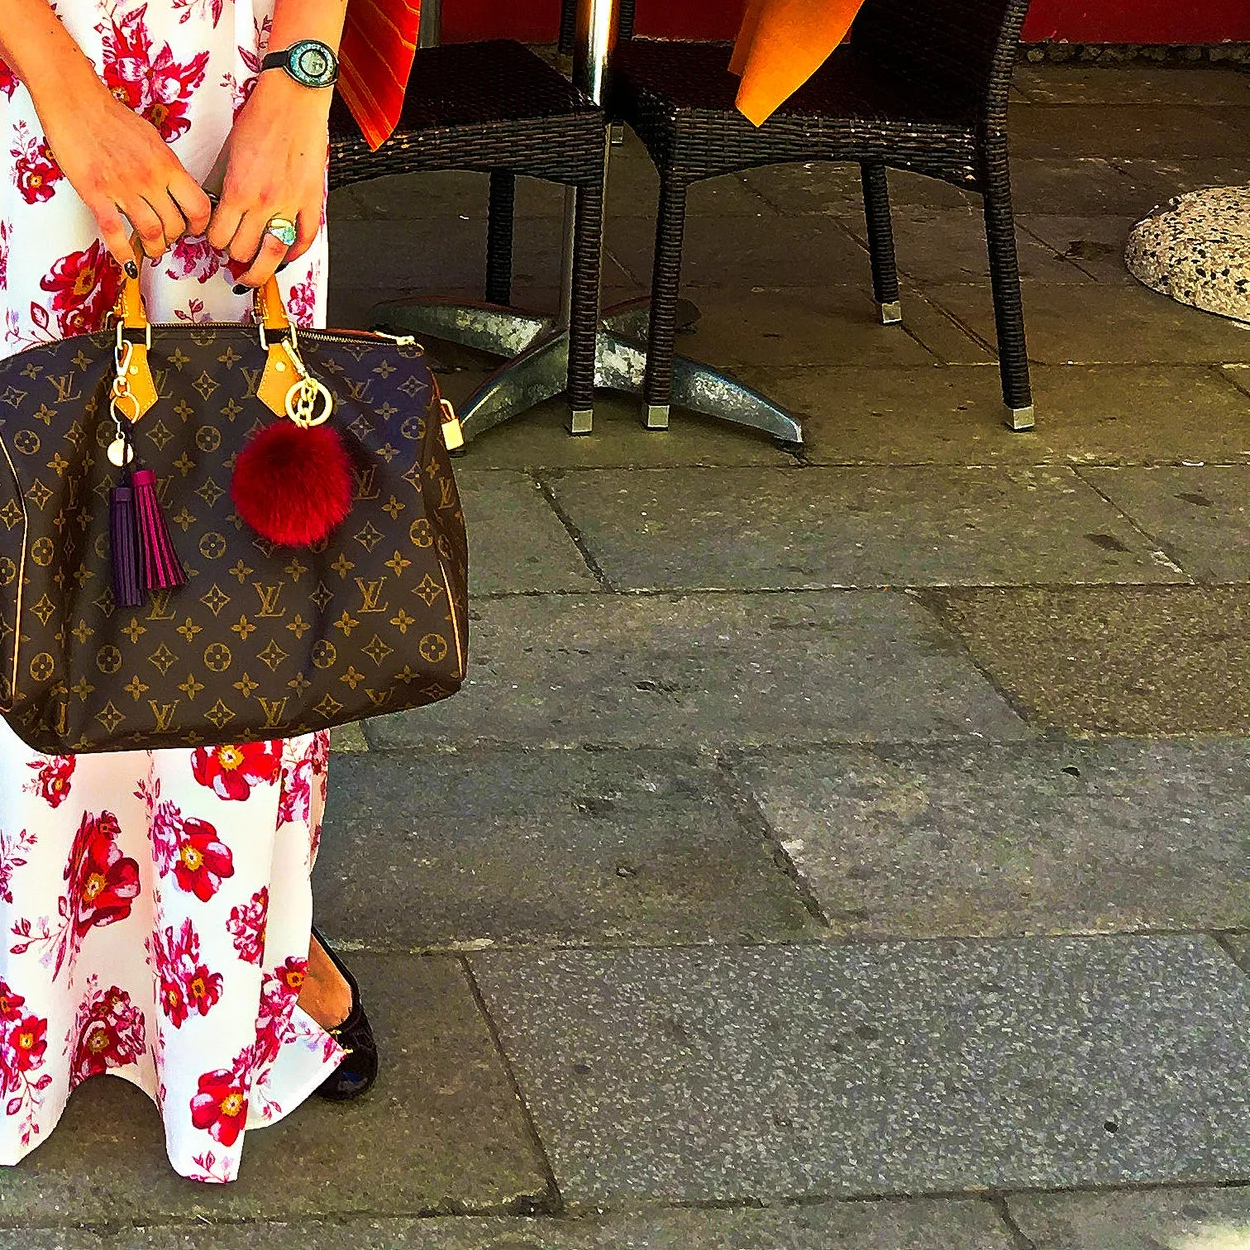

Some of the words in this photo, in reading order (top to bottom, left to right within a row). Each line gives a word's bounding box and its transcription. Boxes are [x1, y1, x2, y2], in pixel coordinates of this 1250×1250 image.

[46, 370, 83, 404] LV
[342, 376, 374, 404] LV
[252, 582, 287, 618] LV
[353, 576, 389, 613] LV
[148, 699, 182, 734] LV
[253, 696, 290, 730] LV
